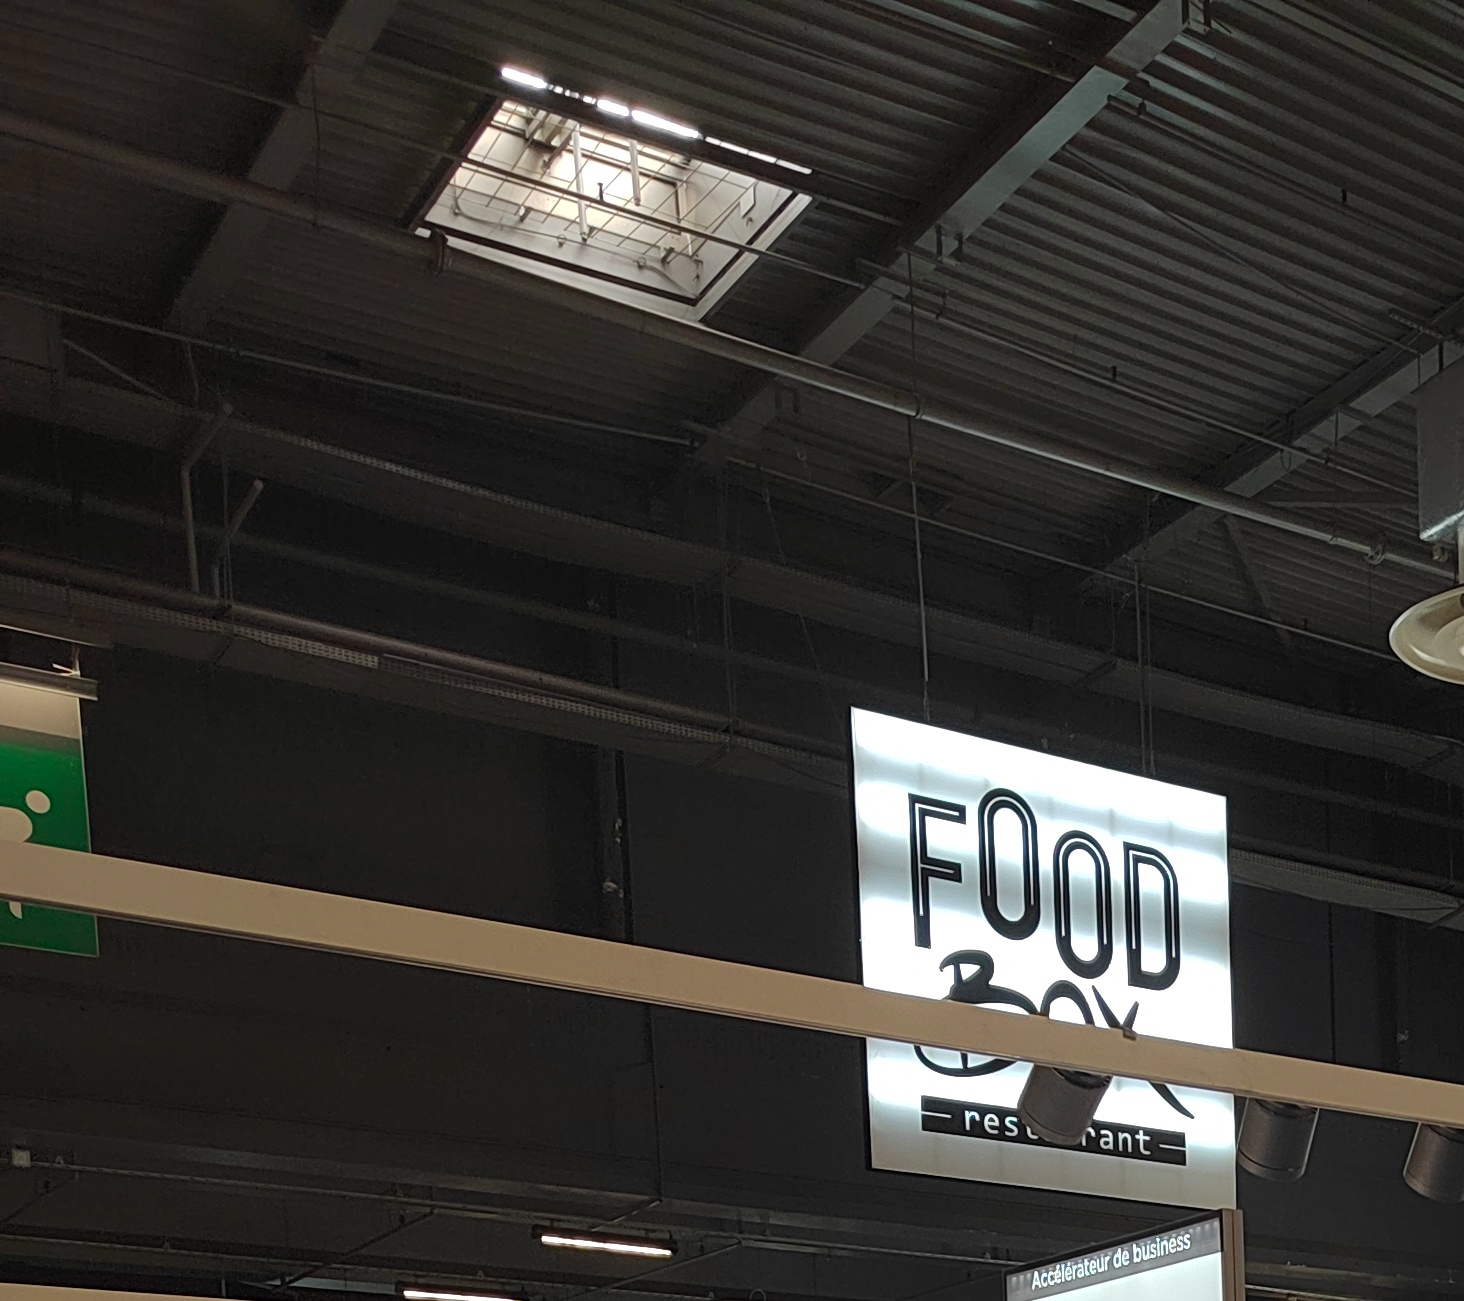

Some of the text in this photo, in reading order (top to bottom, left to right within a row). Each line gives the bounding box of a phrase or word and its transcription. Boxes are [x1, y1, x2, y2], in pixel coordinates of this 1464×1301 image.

[908, 788, 1181, 990] FOOD
[964, 1109, 1152, 1156] resrant
[1031, 1233, 1191, 1291] Accélérateur de business
